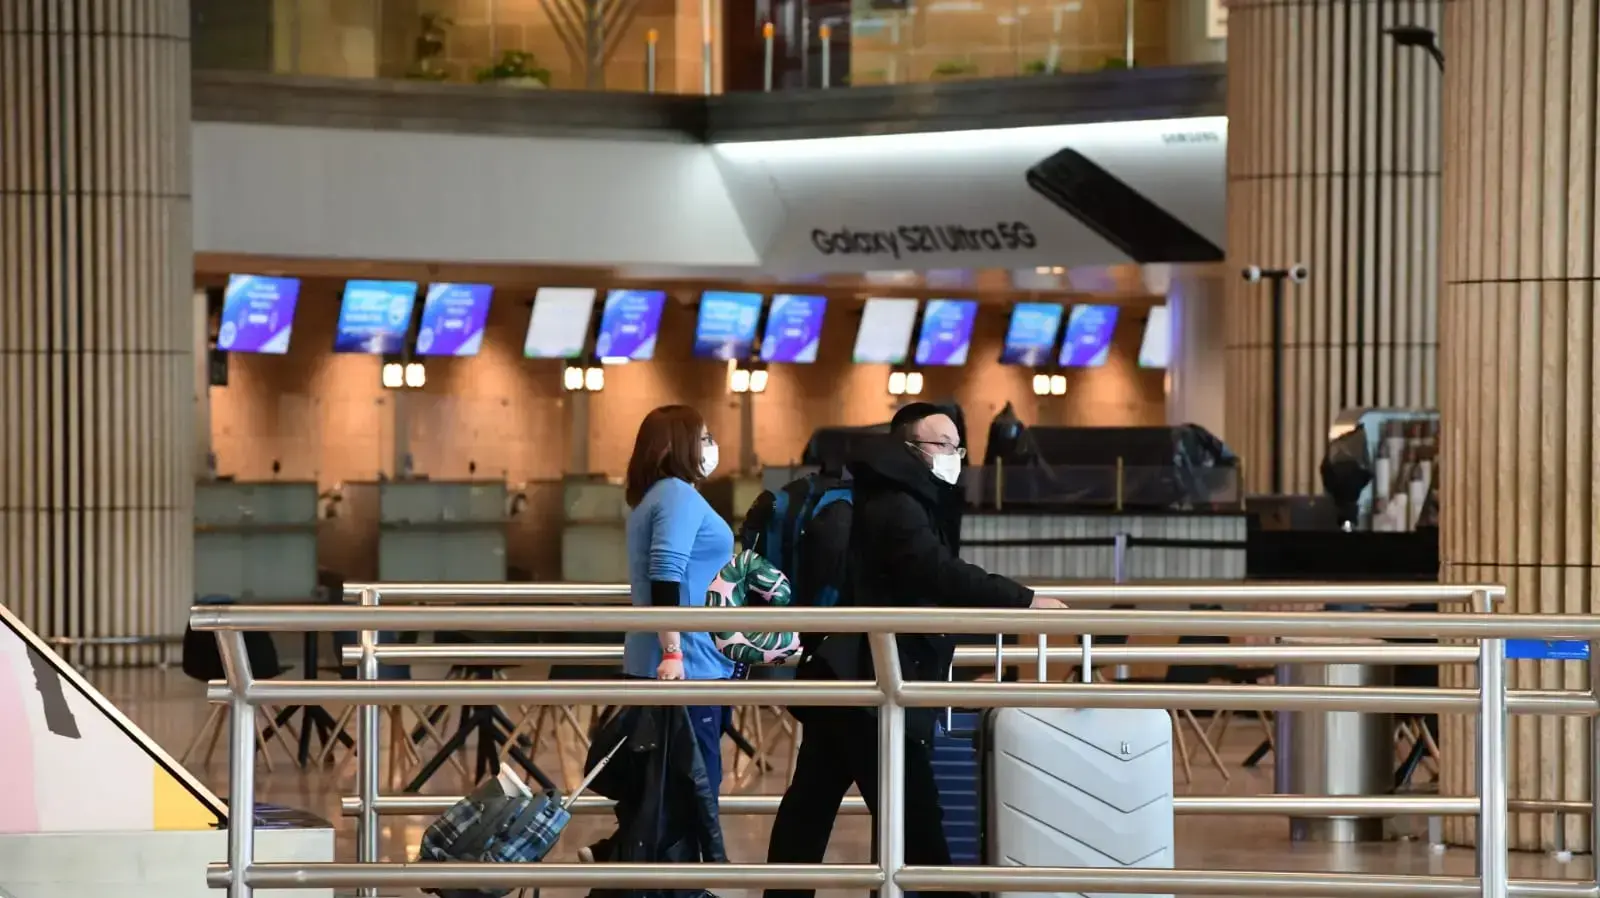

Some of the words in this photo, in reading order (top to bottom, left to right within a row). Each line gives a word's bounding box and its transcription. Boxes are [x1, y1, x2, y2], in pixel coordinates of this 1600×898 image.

[811, 226, 901, 260] Galaxy
[897, 224, 941, 253] S21
[936, 223, 1000, 252] Ultra
[997, 220, 1038, 250] 5G
